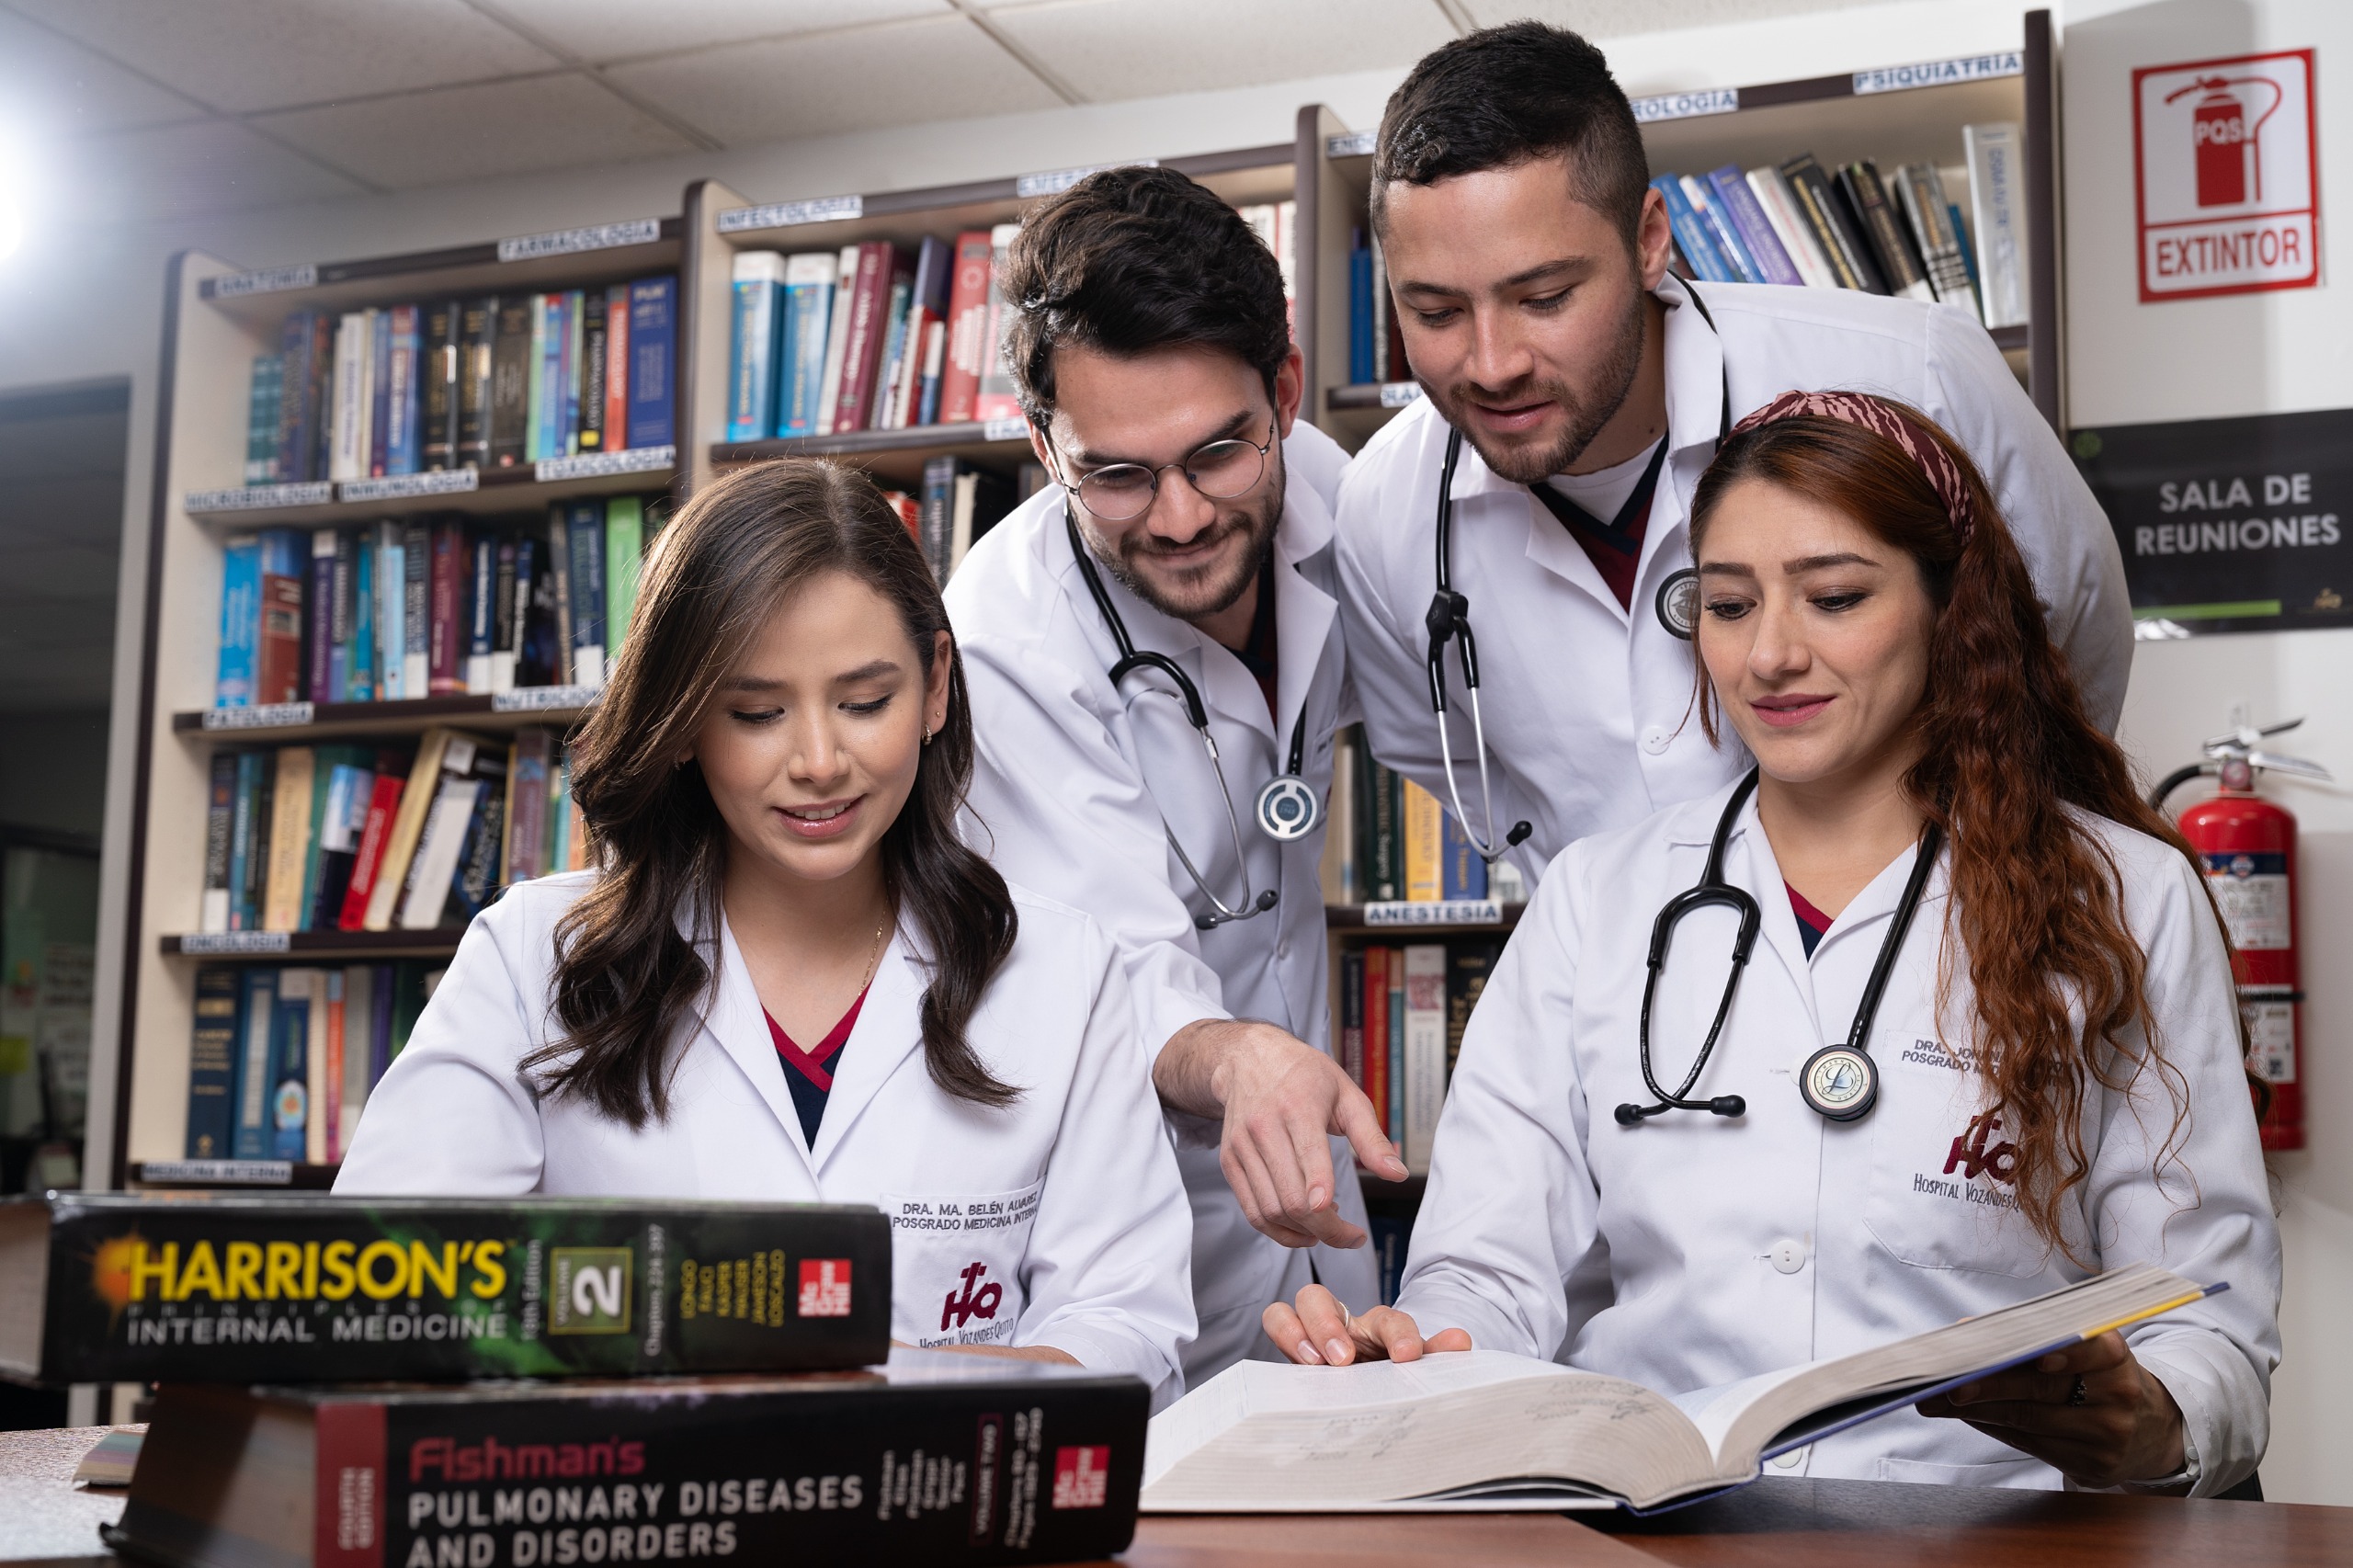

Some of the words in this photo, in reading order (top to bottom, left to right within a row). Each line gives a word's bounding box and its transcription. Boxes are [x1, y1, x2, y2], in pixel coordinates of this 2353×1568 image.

[1856, 55, 2018, 88] PSIQUIATRIA
[1632, 93, 1734, 118] ROLOGIA
[2196, 118, 2244, 146] PQS
[506, 224, 654, 256] FARMACOLOGIA
[2156, 229, 2301, 278] EXTINTOR
[542, 450, 674, 476] TOXICOLOGIA
[2160, 477, 2253, 512] SALA
[2264, 473, 2312, 506] DE
[2135, 514, 2341, 555] REUNIONES
[1369, 904, 1498, 922] ANESTESIA
[1902, 1051, 1971, 1072] POSGRADO
[1914, 1039, 1946, 1054] DRA.
[903, 1203, 933, 1215] DRA.
[938, 1204, 962, 1216] MA.
[968, 1201, 1004, 1215] BELÉN
[1914, 1173, 1959, 1199] HOSPITAL
[1965, 1182, 2012, 1209] VOZANDES
[892, 1217, 961, 1230] POSGRADO
[964, 1216, 1012, 1230] MEDICINA
[128, 1239, 507, 1301] HARRISON'S
[521, 1239, 542, 1301] Edition
[556, 1257, 571, 1326] VOLUME
[572, 1265, 622, 1317] 2
[679, 1258, 698, 1319] LONGO
[800, 1282, 817, 1316] Mc
[817, 1261, 835, 1316] Graw
[834, 1283, 851, 1316] Hill
[128, 1299, 421, 1319] PRINCIPLES
[644, 1290, 664, 1356] Chapters
[128, 1315, 315, 1346] INTERNAL
[333, 1313, 507, 1342] MEDICINE
[959, 1326, 994, 1345] VOZANDES
[994, 1318, 1013, 1340] QUITO
[409, 1436, 645, 1483] Fishman's
[979, 1424, 997, 1465] TWO
[1053, 1471, 1074, 1507] Mc
[1071, 1448, 1093, 1507] Graw
[1090, 1470, 1107, 1506] Hill
[408, 1482, 664, 1529] PULMONARY
[678, 1474, 863, 1517] DISEASES
[975, 1468, 995, 1535] VOLUME
[405, 1532, 495, 1568] AND
[513, 1521, 737, 1568] DISORDERS
